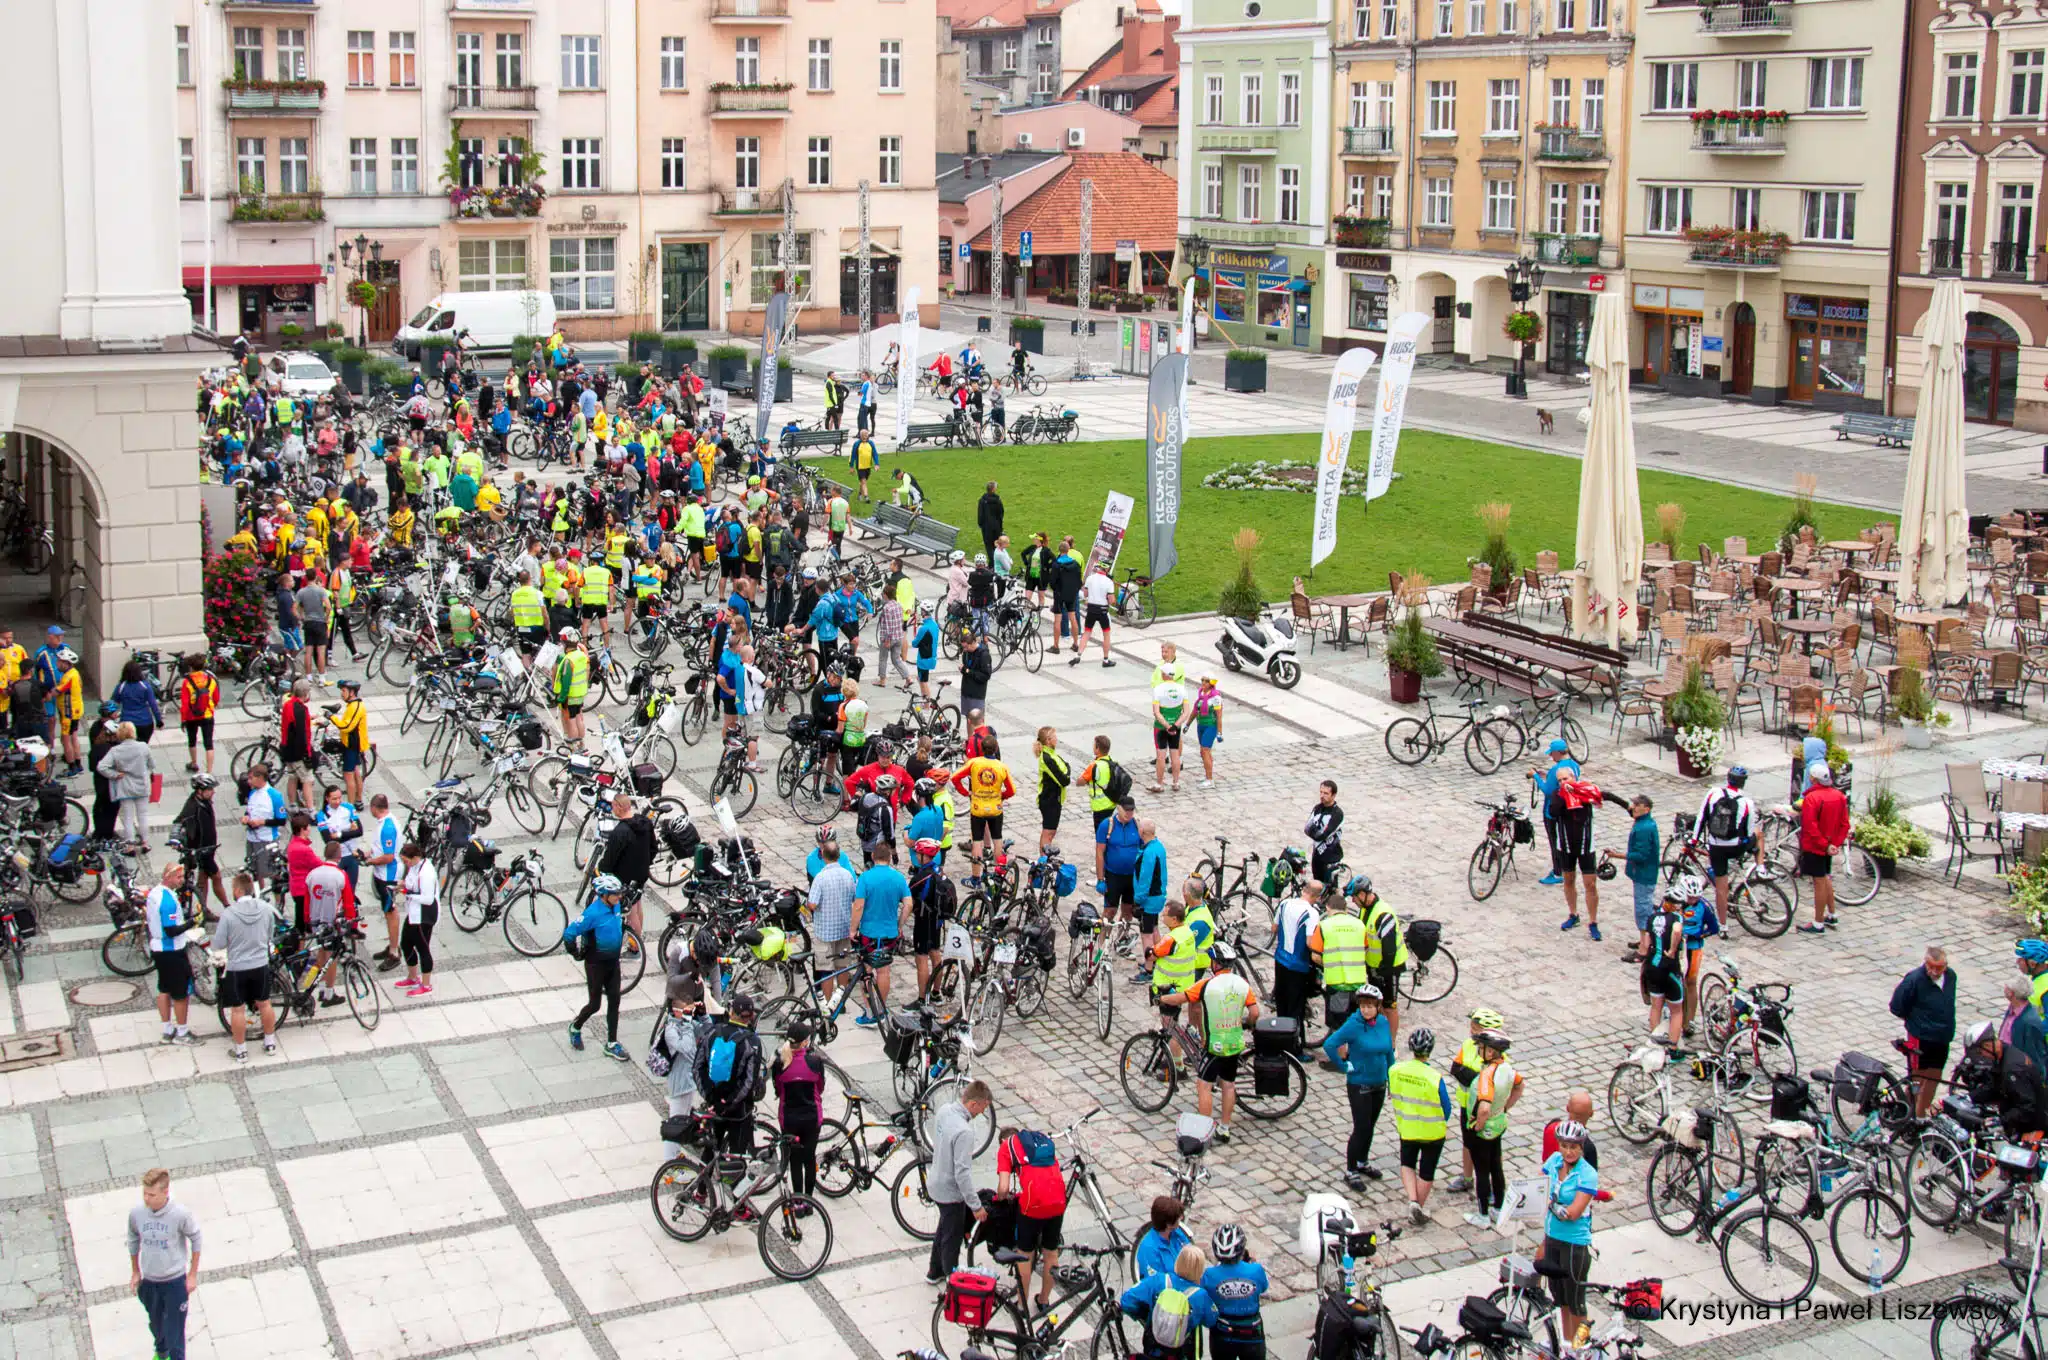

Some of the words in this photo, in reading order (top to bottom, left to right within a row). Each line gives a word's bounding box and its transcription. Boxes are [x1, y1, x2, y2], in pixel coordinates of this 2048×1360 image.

[961, 245, 969, 257] P
[1210, 250, 1272, 270] Delikatesy
[1343, 255, 1381, 269] APTEKA
[1166, 406, 1180, 483] OUTDOORS
[1374, 415, 1389, 478] REGATTA
[1155, 445, 1166, 525] REGATTA
[1166, 487, 1178, 525] GREAT
[1319, 468, 1337, 541] REGATTA
[952, 936, 962, 949] 3
[1516, 1193, 1526, 1209] 2
